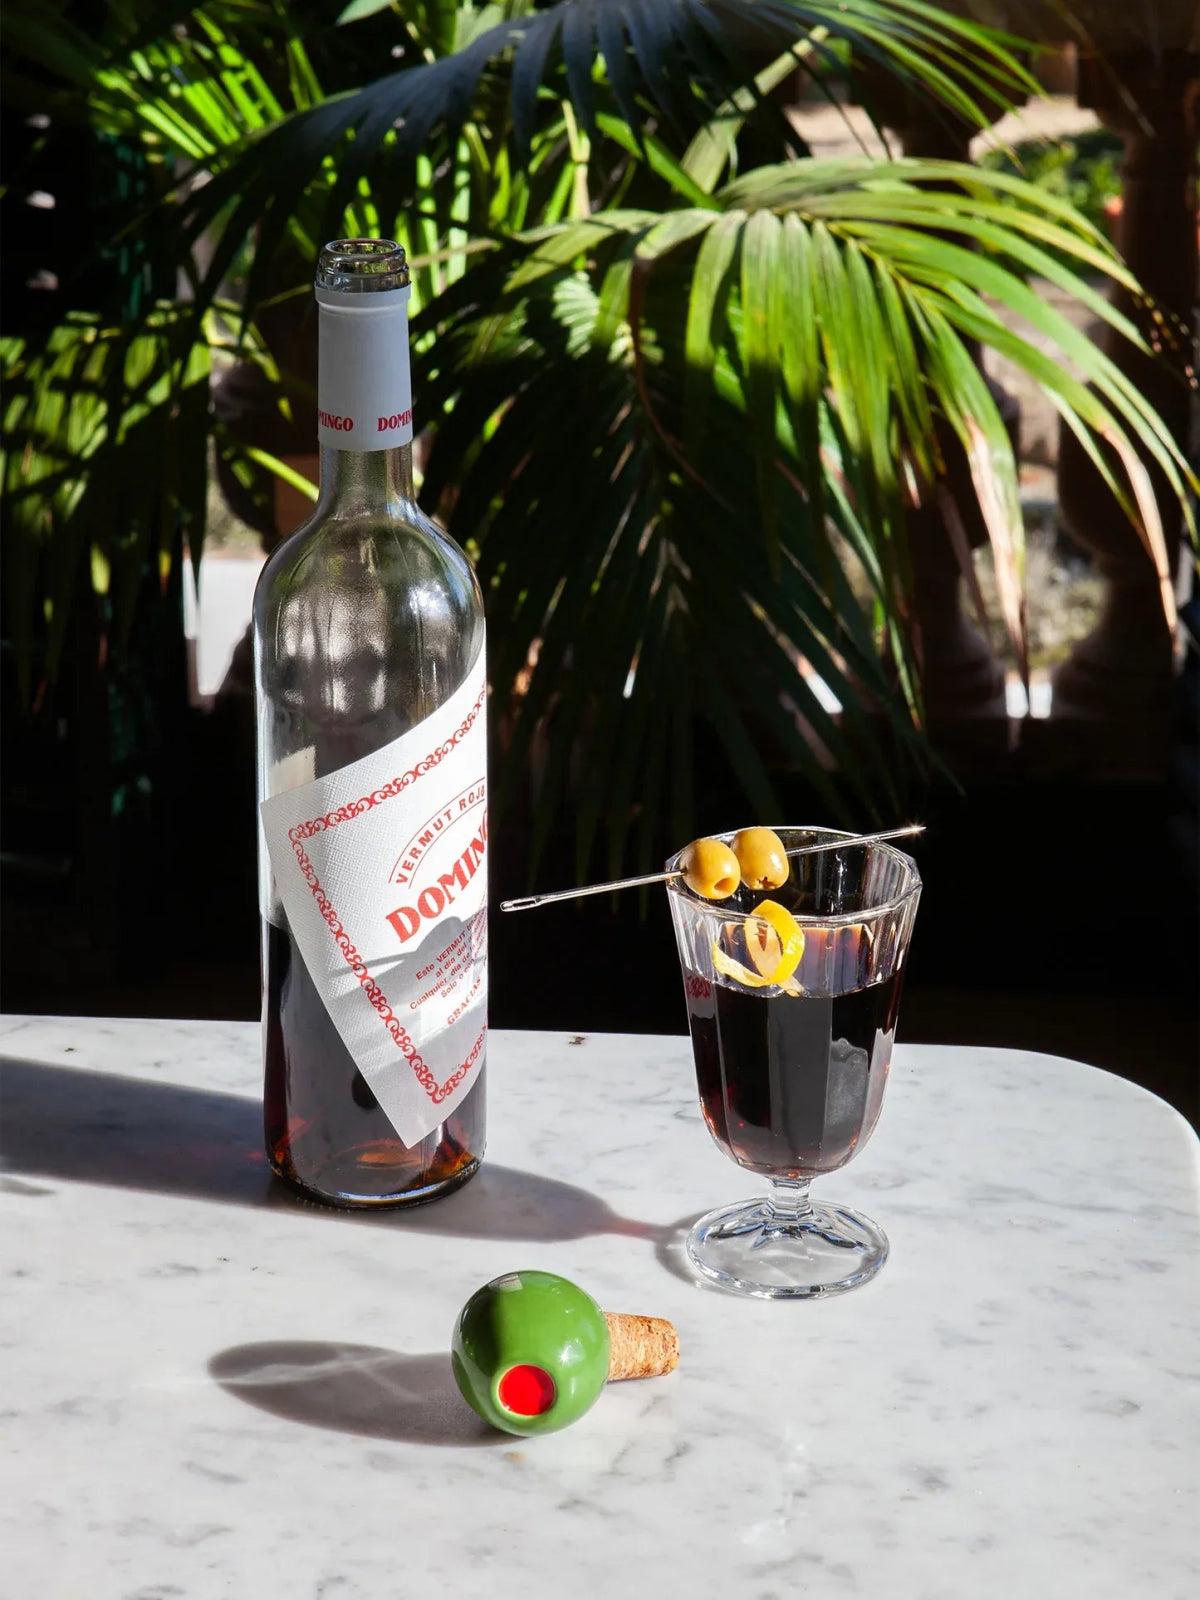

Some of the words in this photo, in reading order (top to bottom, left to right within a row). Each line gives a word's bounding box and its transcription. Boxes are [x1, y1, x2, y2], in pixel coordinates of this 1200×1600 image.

[396, 809, 452, 884] VERMUT
[458, 784, 485, 811] ROJO
[415, 963, 435, 980] Este
[436, 930, 466, 962] VERMUT
[435, 968, 444, 978] al
[457, 942, 467, 957] del
[409, 977, 448, 1010] Cualquier
[462, 952, 470, 964] de
[440, 981, 457, 998] Solo
[447, 977, 482, 1026] GRACIAS
